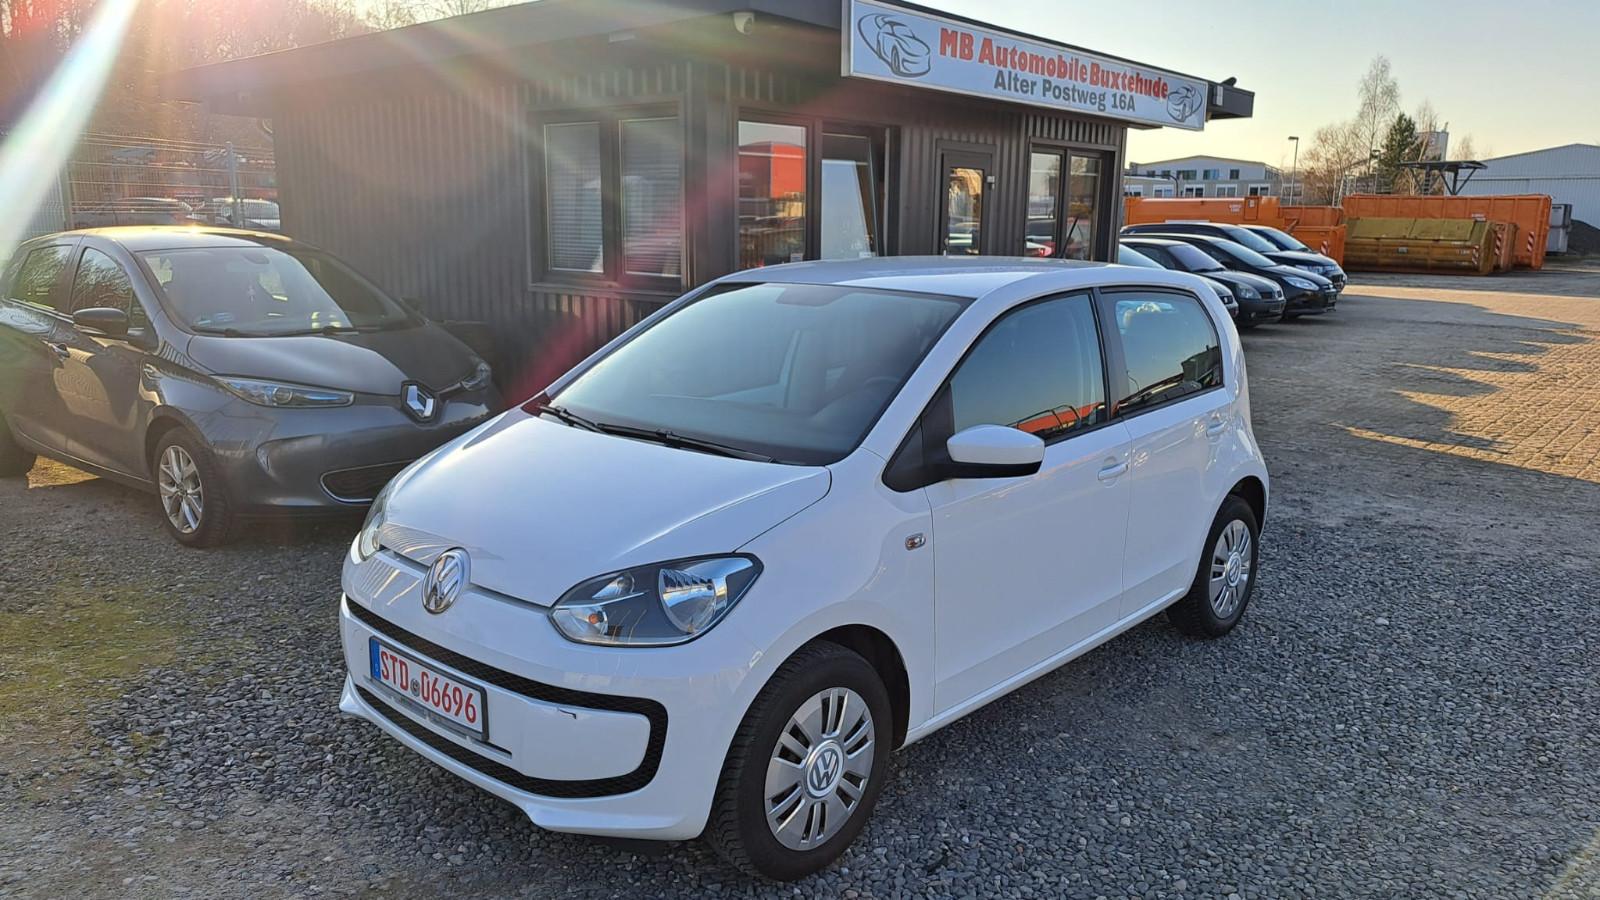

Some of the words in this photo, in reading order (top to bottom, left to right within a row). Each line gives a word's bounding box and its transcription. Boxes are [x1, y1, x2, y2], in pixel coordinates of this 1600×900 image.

[939, 28, 973, 61] MB
[978, 38, 1088, 83] Automobile
[1089, 63, 1168, 99] Buxtehude
[993, 70, 1037, 94] Alter
[1042, 81, 1106, 112] Postweg
[1111, 93, 1136, 112] 16A
[380, 650, 409, 691] STD
[421, 671, 477, 724] 06696
